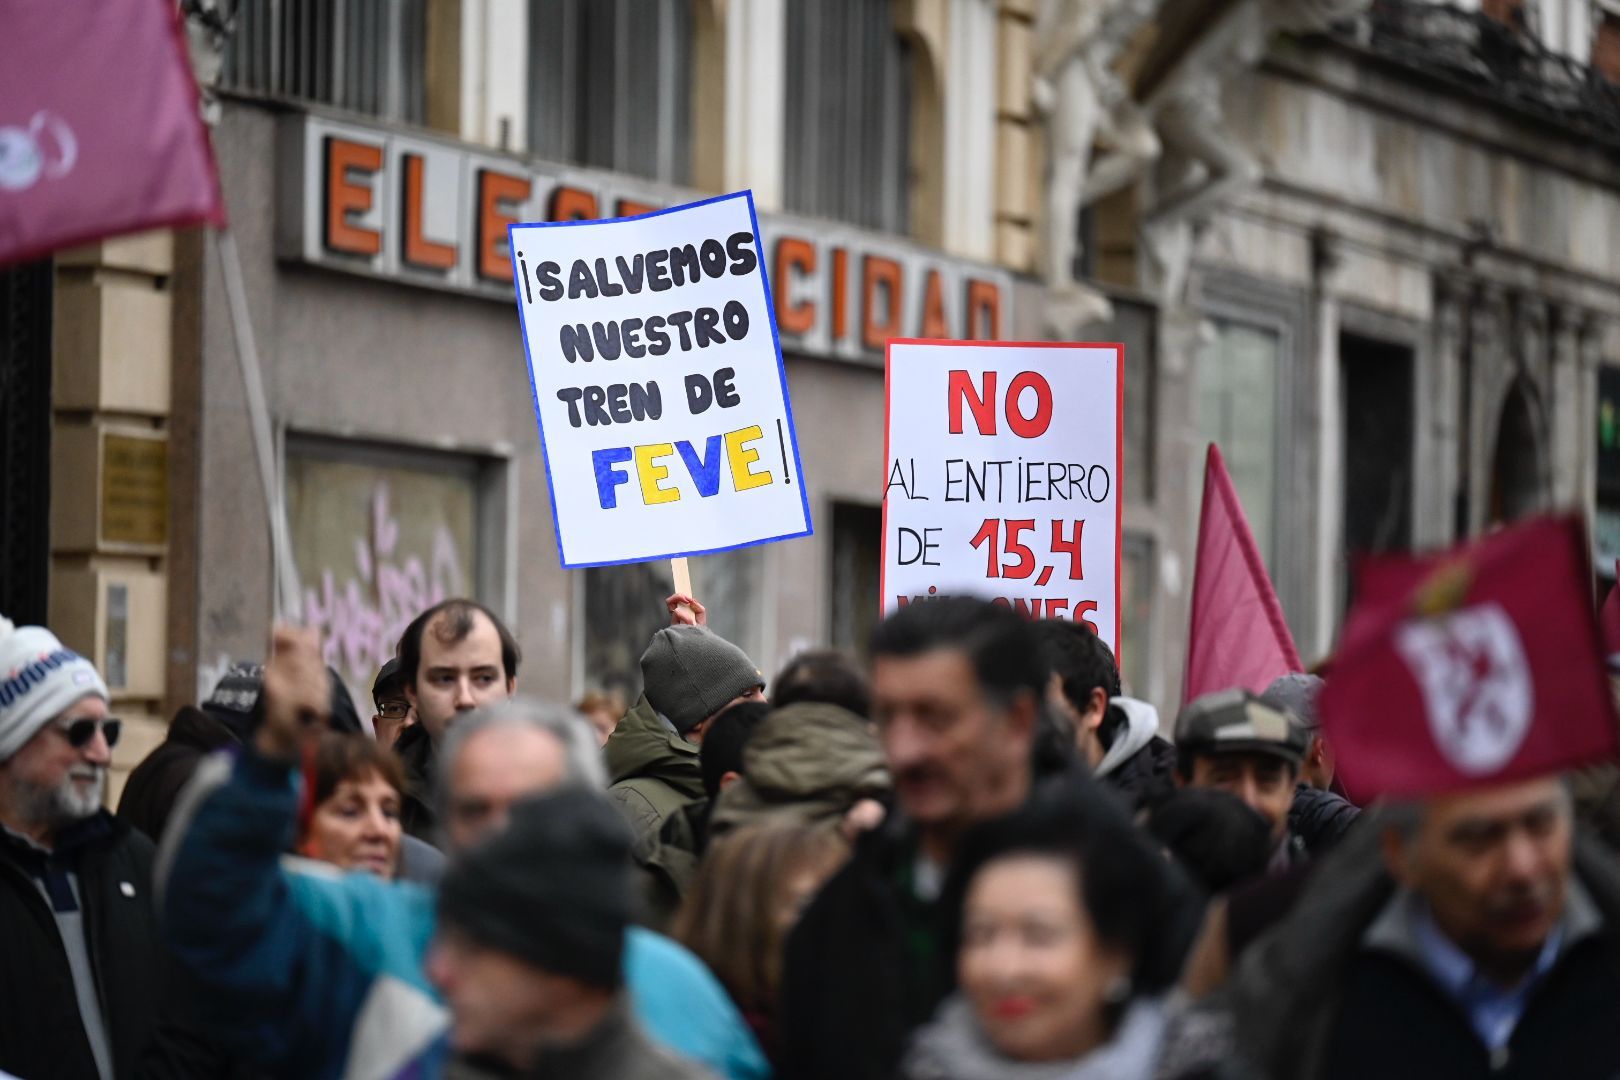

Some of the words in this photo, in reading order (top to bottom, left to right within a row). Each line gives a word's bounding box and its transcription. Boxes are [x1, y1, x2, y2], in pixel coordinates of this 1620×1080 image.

[324, 137, 999, 347] ELECIDAD
[517, 231, 757, 304] ¡SALVEMOS
[560, 300, 750, 363] NUESTRO
[557, 380, 663, 428] TREN
[684, 367, 741, 415] DE
[948, 370, 1053, 438] NO
[591, 418, 791, 510] FEVE!
[883, 458, 929, 501] AL
[898, 527, 943, 566] DE
[969, 518, 1085, 586] 15,4
